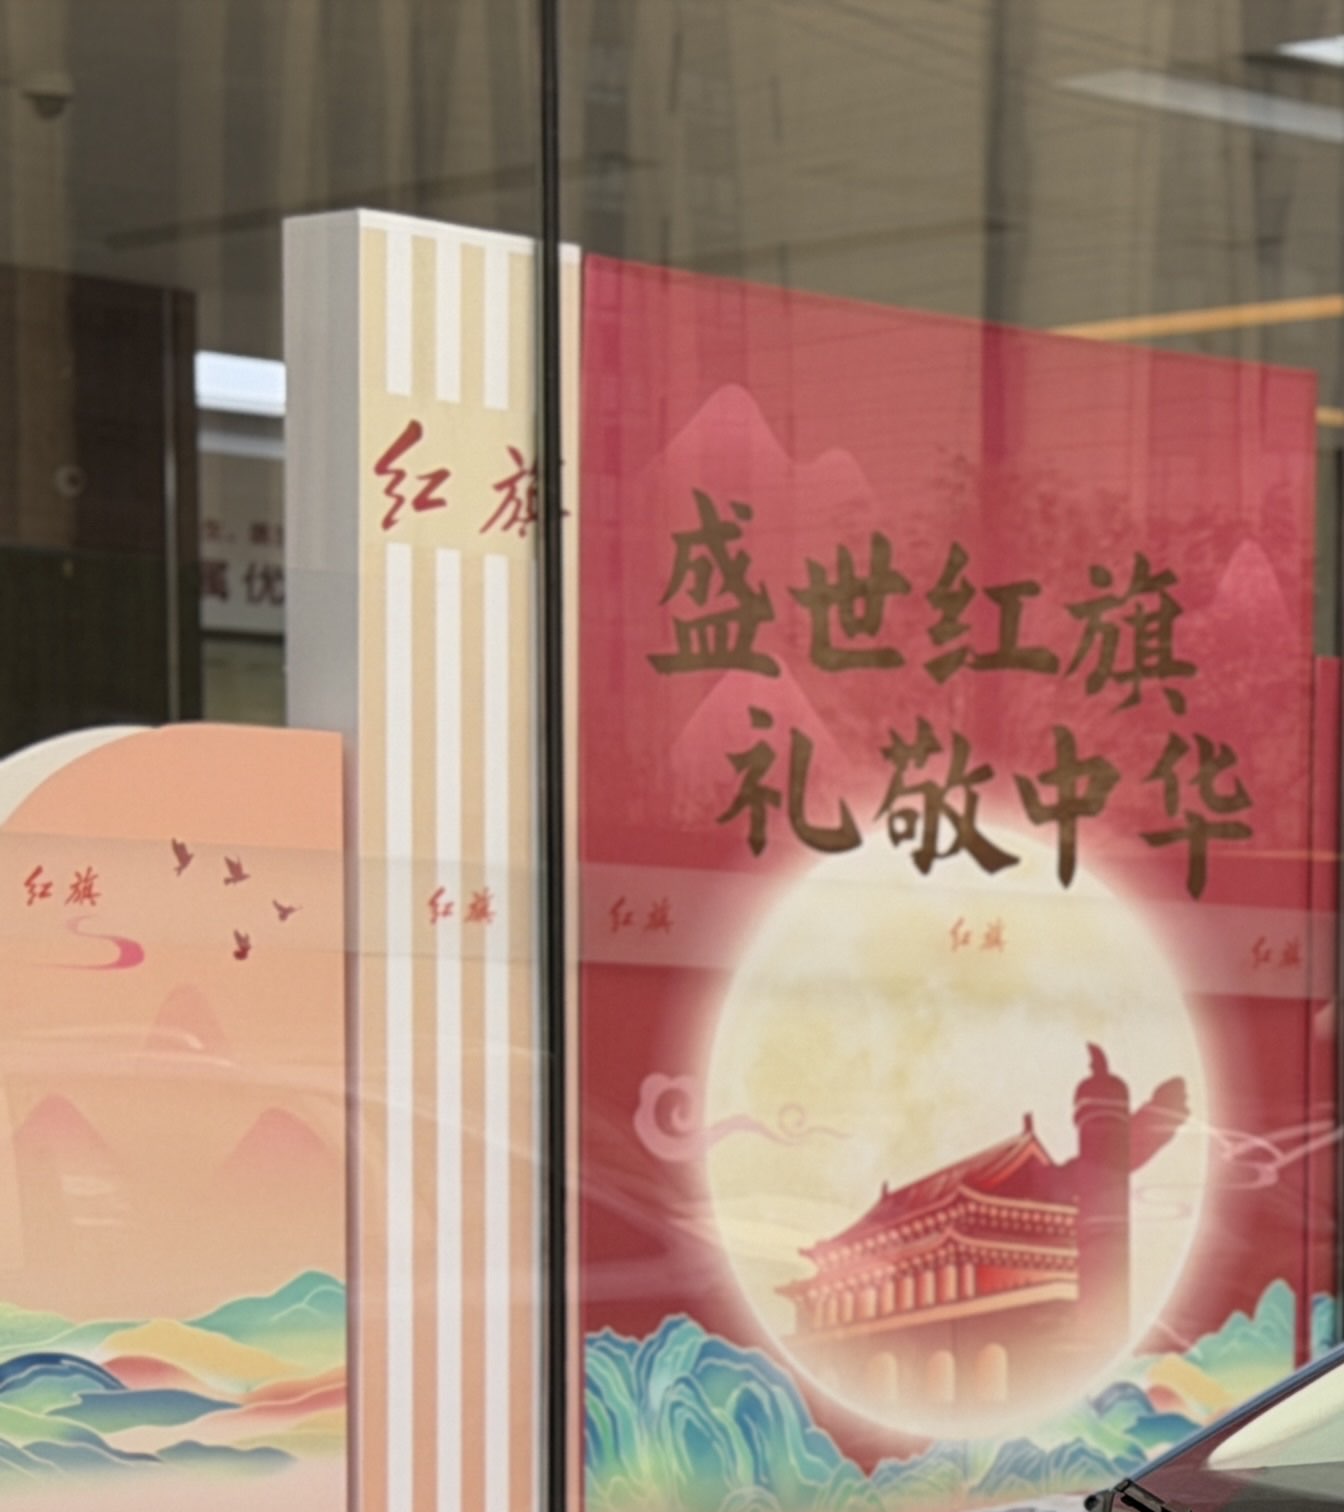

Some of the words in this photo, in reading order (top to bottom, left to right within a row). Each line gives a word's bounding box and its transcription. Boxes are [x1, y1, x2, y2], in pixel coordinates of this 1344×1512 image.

[646, 487, 1199, 717] 盛世红旗
[714, 704, 1254, 901] 礼敬中华
[23, 865, 101, 907] 红旗
[427, 886, 497, 925] 红旗
